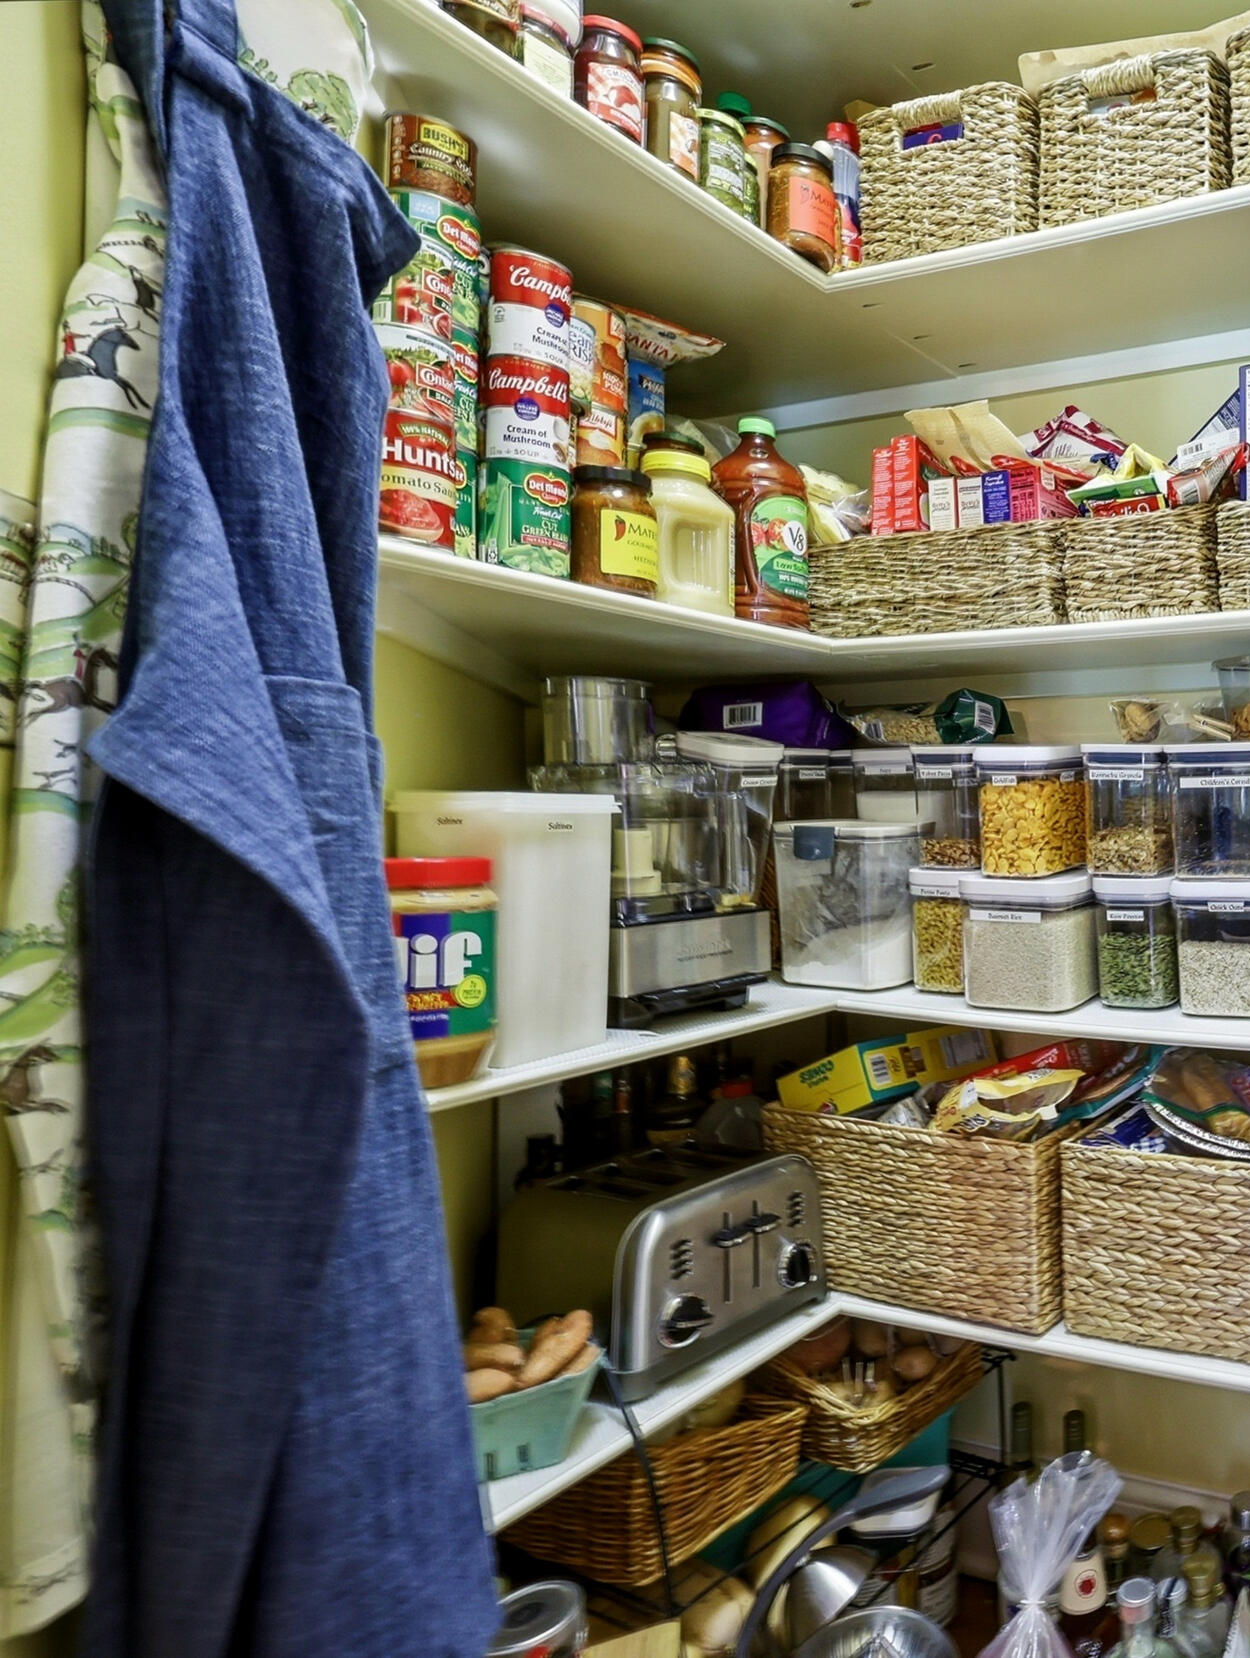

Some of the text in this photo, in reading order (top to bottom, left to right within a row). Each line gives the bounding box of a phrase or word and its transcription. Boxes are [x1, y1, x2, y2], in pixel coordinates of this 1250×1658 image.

[488, 366, 568, 403] Campbell's
[503, 434, 551, 449] Mushroom
[506, 425, 547, 439] Cream of
[788, 525, 805, 552] V8
